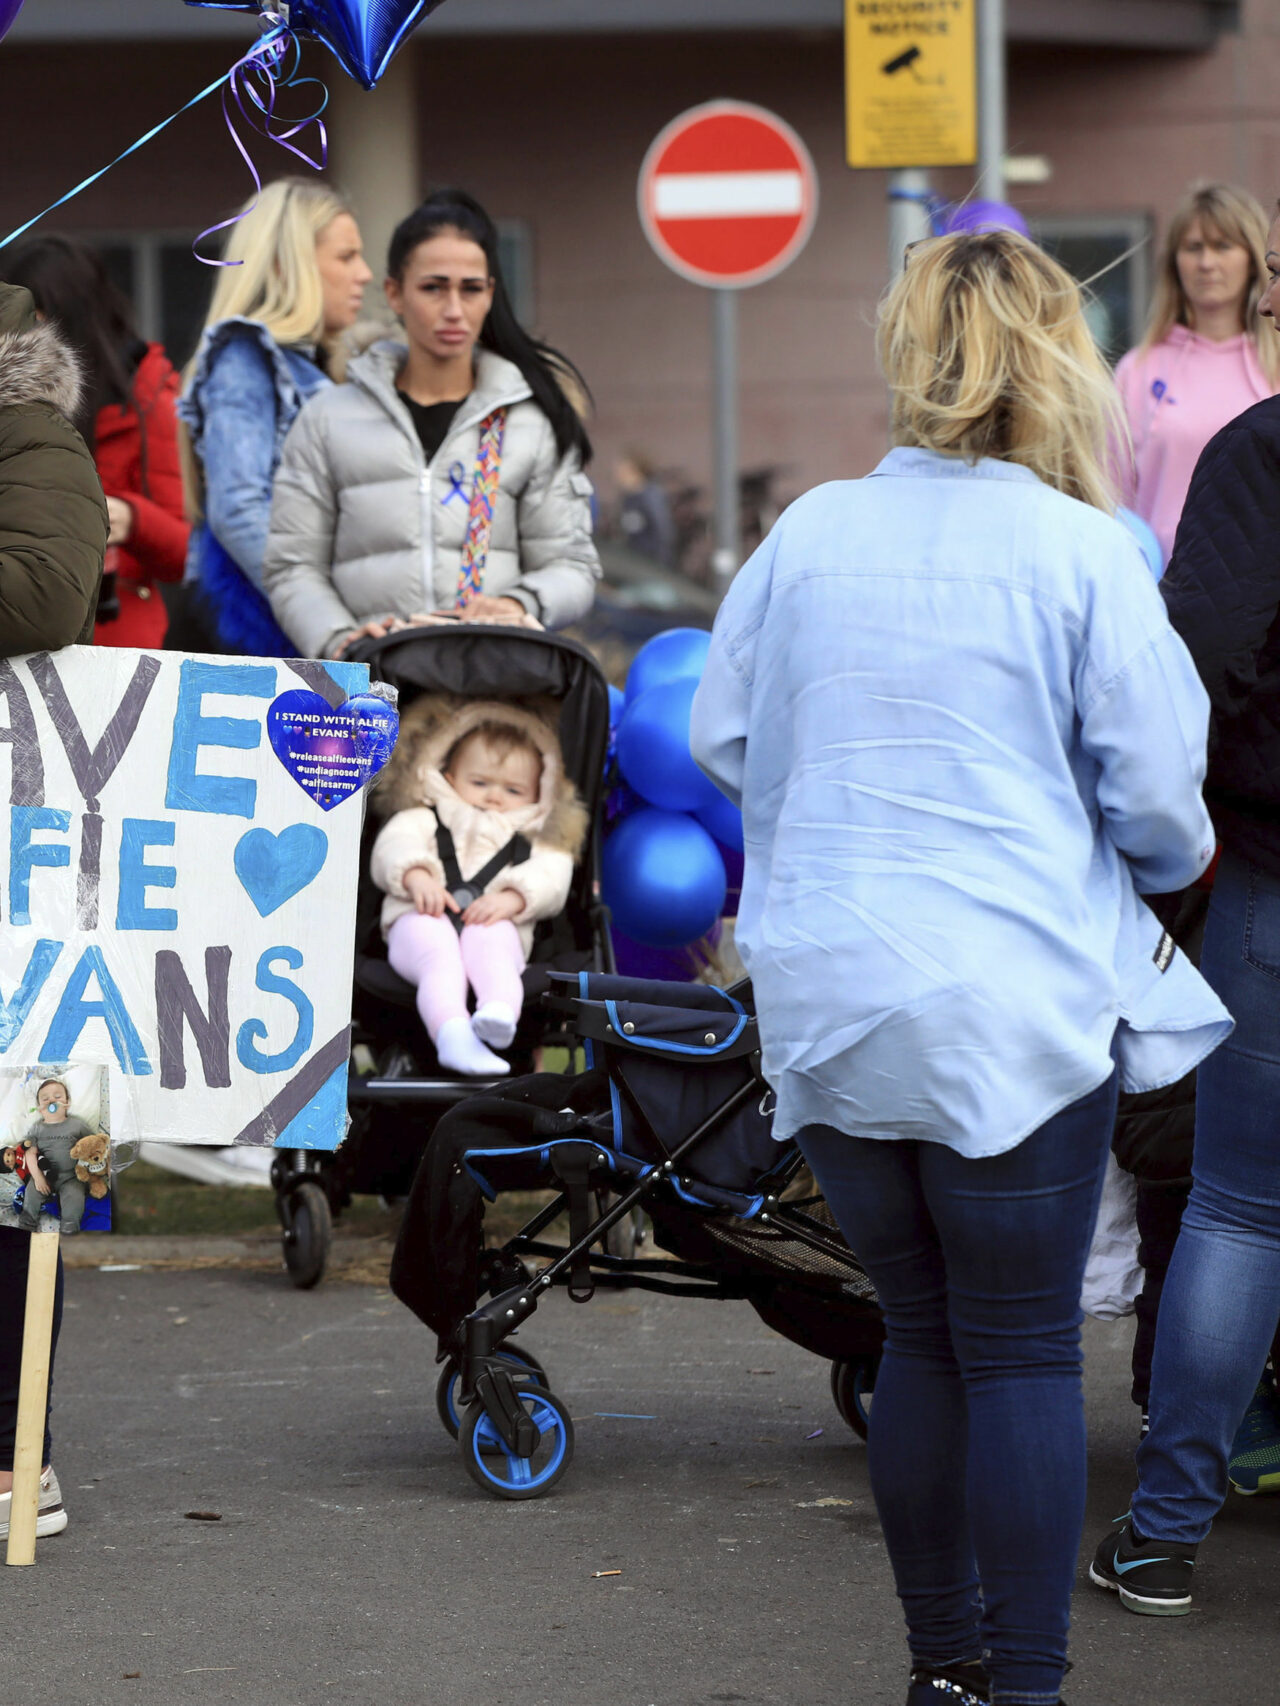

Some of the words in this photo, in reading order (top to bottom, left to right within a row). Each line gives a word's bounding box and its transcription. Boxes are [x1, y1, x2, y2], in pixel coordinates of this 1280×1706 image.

[274, 711, 280, 721] I
[282, 712, 321, 723] STAND
[323, 715, 355, 726] WITH
[357, 718, 389, 729] ALFIE
[312, 728, 349, 739] EVANS
[296, 764, 360, 778] #undiagnosed
[300, 777, 357, 791] #alfiesarmy
